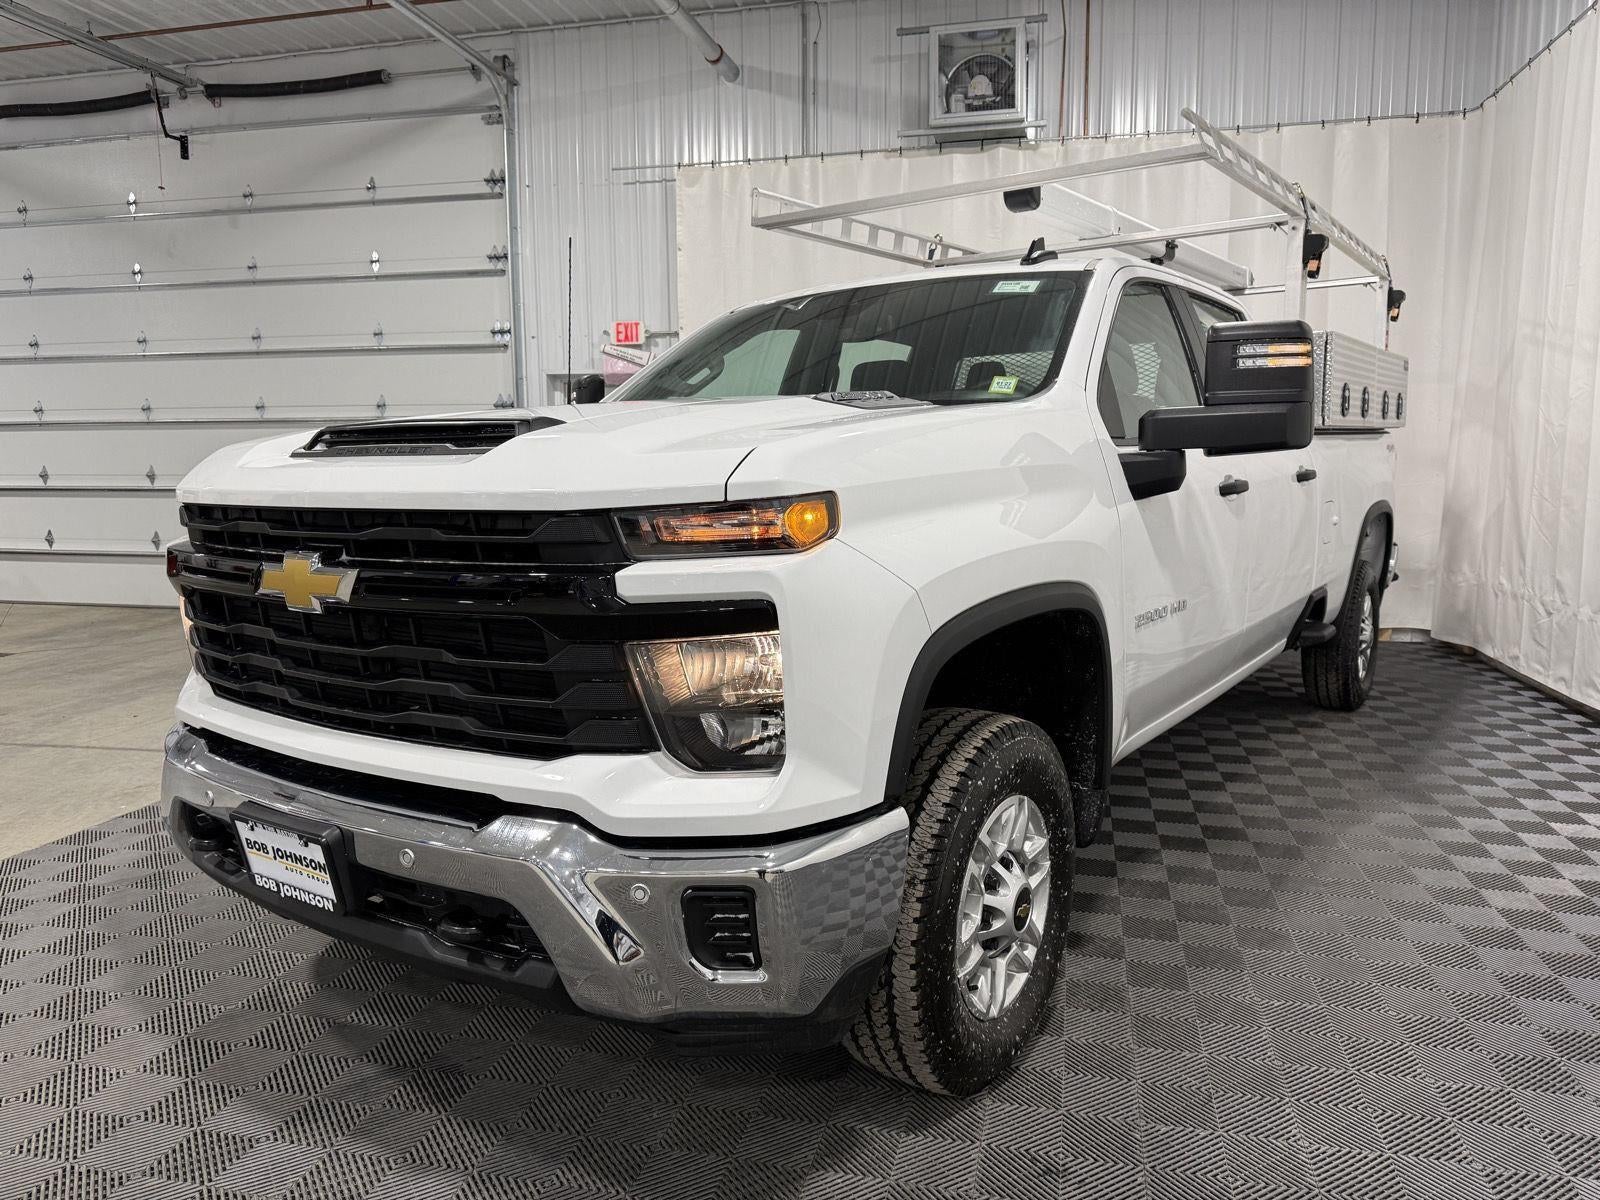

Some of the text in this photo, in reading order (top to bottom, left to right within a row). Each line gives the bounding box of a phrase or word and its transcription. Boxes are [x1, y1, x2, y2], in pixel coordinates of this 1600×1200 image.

[615, 322, 640, 342] EXIT
[336, 447, 433, 456] CHEVROLET
[245, 838, 328, 875] BOB JOHNSON
[285, 865, 329, 885] AUTO GROUP
[254, 873, 334, 912] BOB JOHNSON
